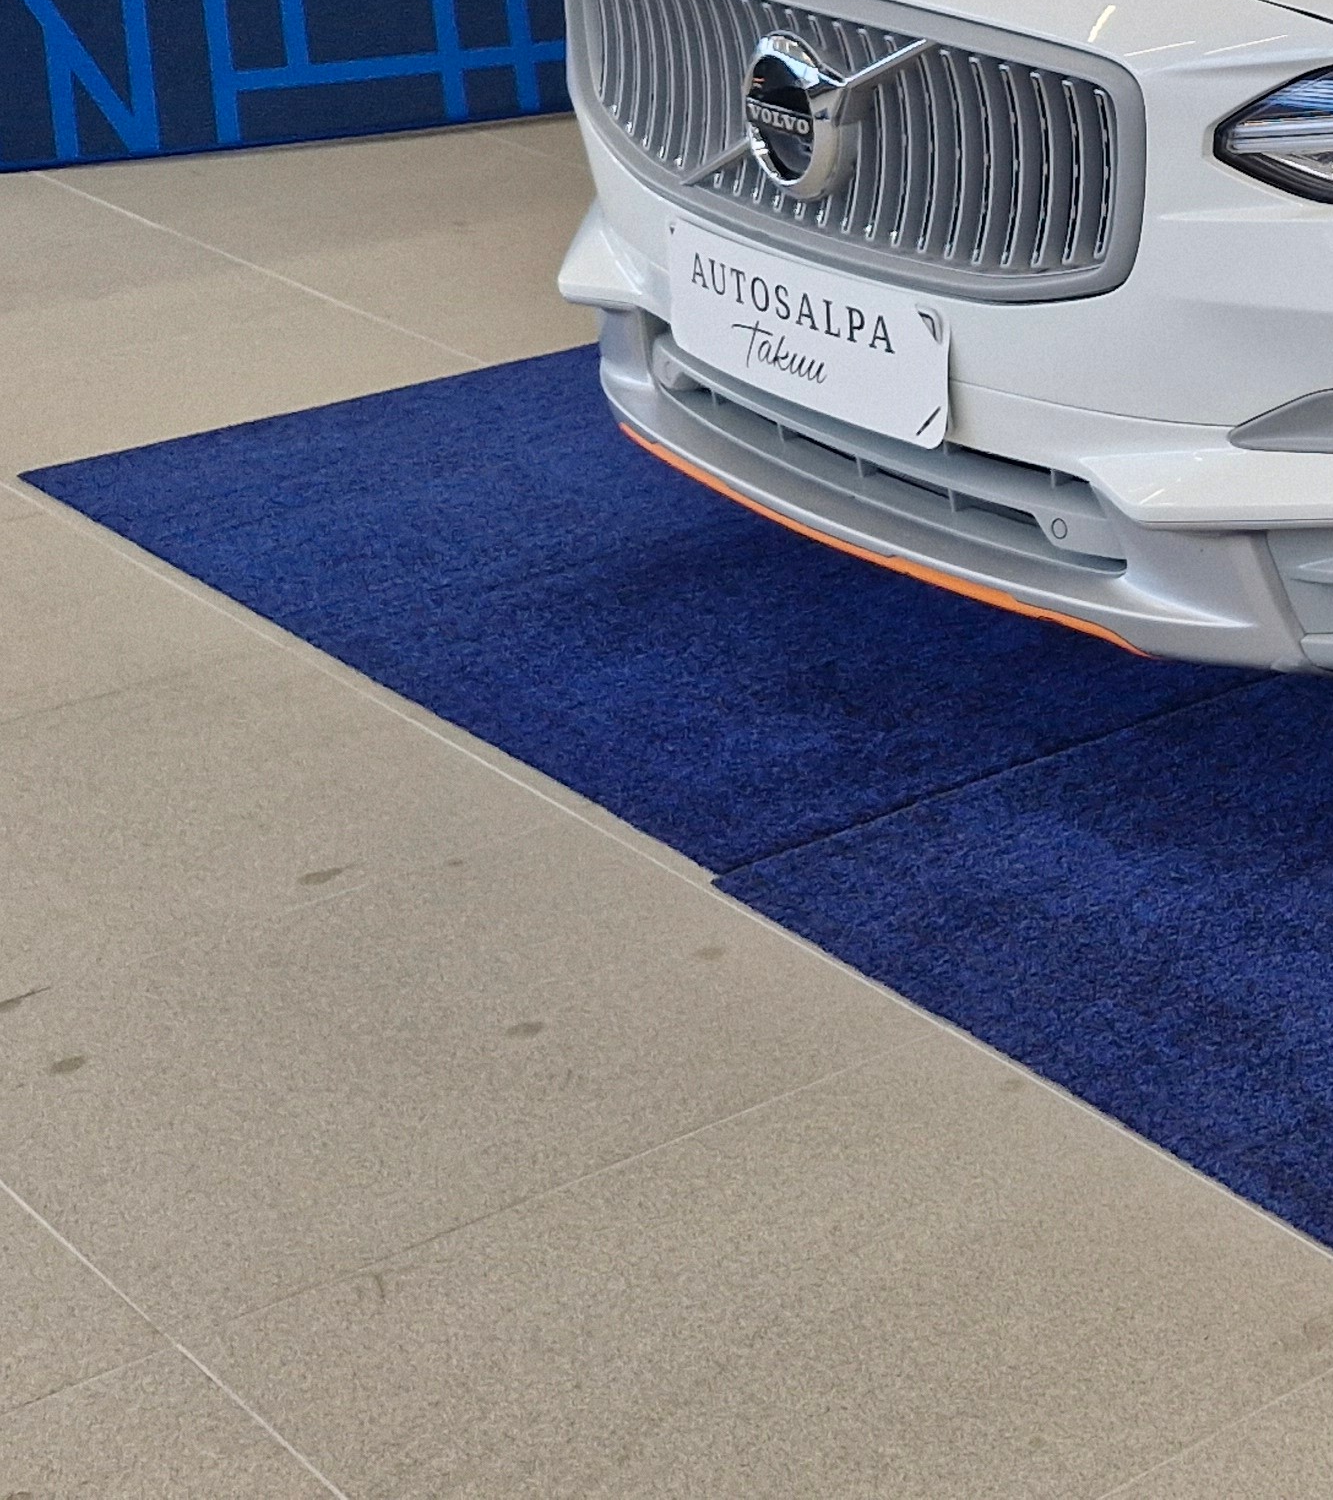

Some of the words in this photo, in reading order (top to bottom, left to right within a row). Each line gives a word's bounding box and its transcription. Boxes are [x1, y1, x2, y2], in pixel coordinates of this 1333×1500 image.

[747, 102, 811, 135] VOLVO
[691, 251, 896, 356] AUTOSALPA
[731, 319, 829, 385] Takuu
